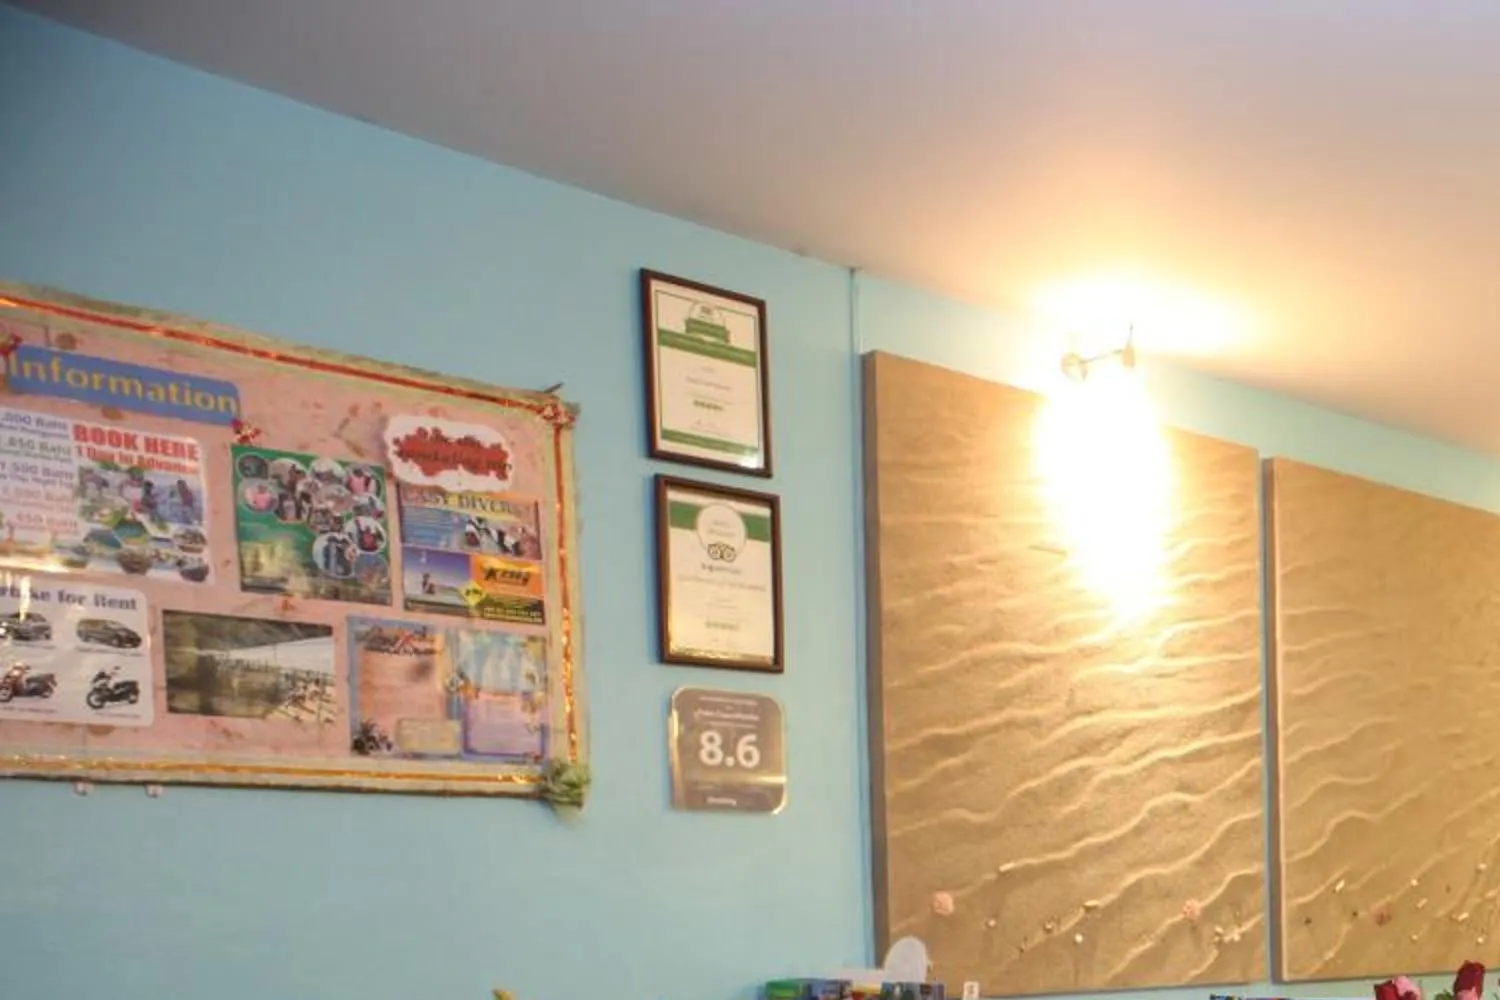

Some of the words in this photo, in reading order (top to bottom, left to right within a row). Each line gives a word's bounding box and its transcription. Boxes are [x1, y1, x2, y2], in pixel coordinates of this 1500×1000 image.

[9, 354, 239, 414] Information
[74, 423, 138, 450] BOOK
[143, 435, 199, 461] HERE
[57, 589, 87, 605] for
[93, 593, 138, 610] Rent
[699, 730, 760, 769] 8.6
